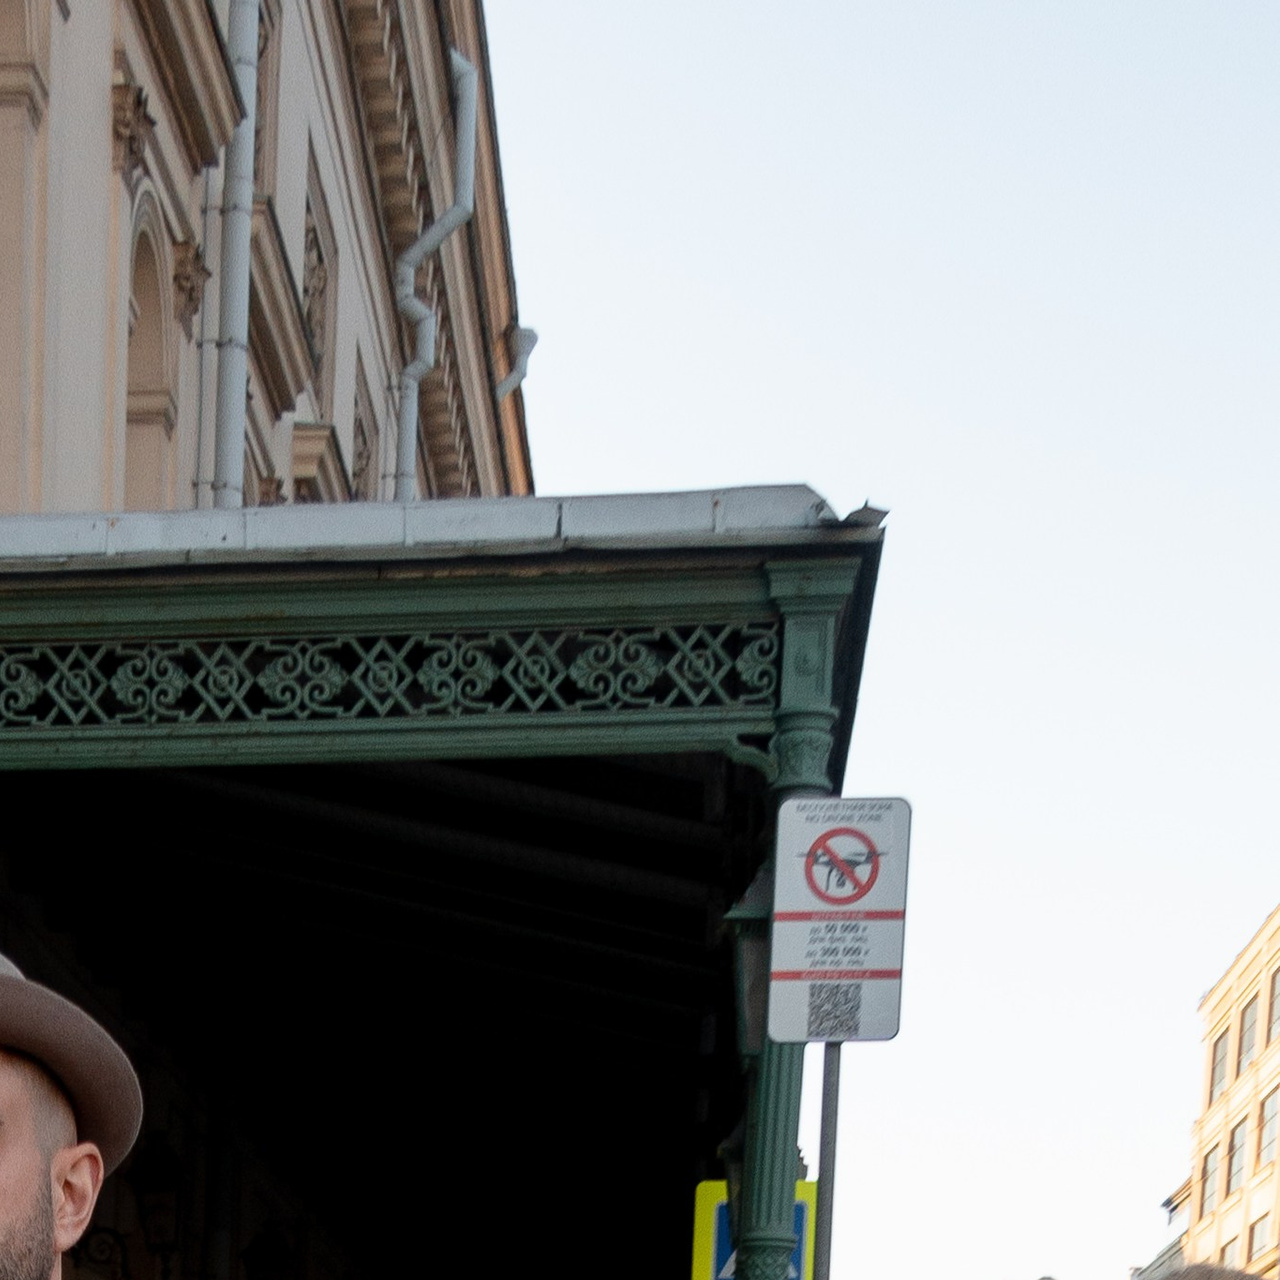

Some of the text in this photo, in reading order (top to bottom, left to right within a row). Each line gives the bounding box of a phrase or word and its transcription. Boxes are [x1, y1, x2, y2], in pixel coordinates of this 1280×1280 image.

[805, 813, 882, 823] NO DRONE ZONE
